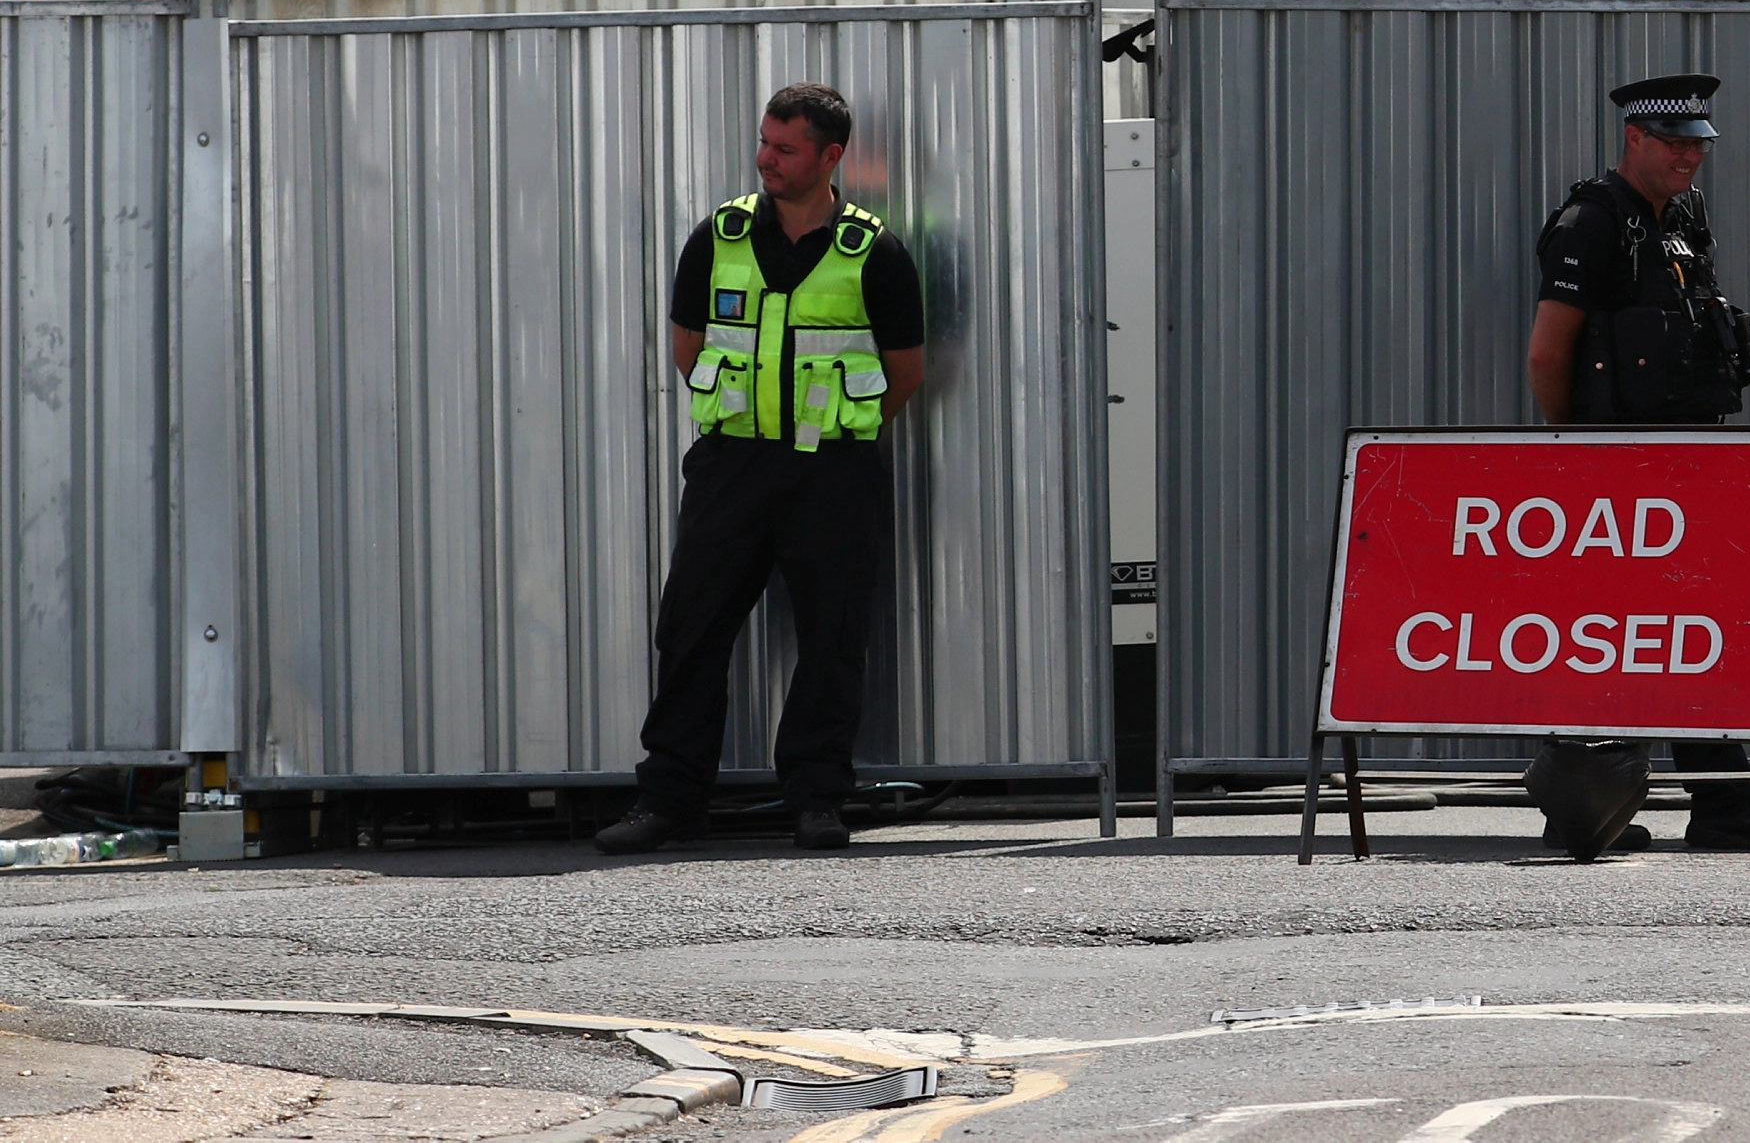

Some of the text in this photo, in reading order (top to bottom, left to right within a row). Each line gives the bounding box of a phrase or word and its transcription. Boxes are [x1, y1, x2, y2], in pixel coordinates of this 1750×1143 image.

[1554, 280, 1579, 291] POLICE
[1452, 496, 1685, 558] ROAD
[1395, 611, 1724, 674] CLOSED
